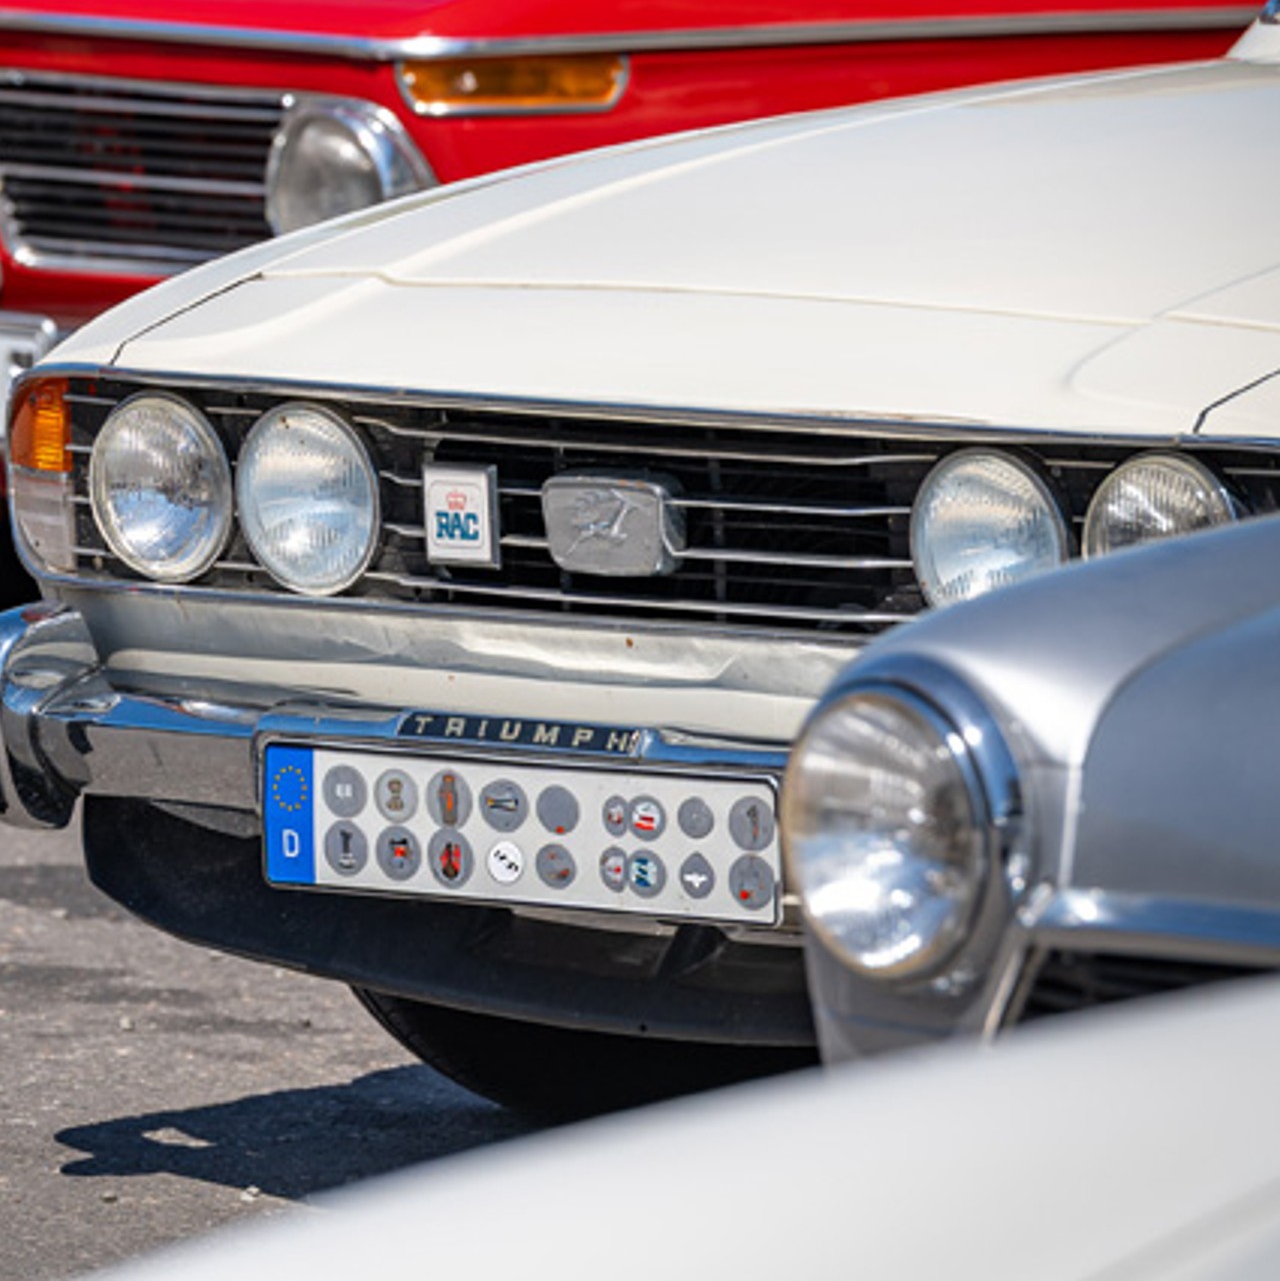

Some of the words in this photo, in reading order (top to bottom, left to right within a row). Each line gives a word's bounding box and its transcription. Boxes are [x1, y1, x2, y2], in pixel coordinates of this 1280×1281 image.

[435, 511, 480, 540] RAC
[415, 717, 628, 752] TRIUMPH
[282, 828, 299, 858] D
